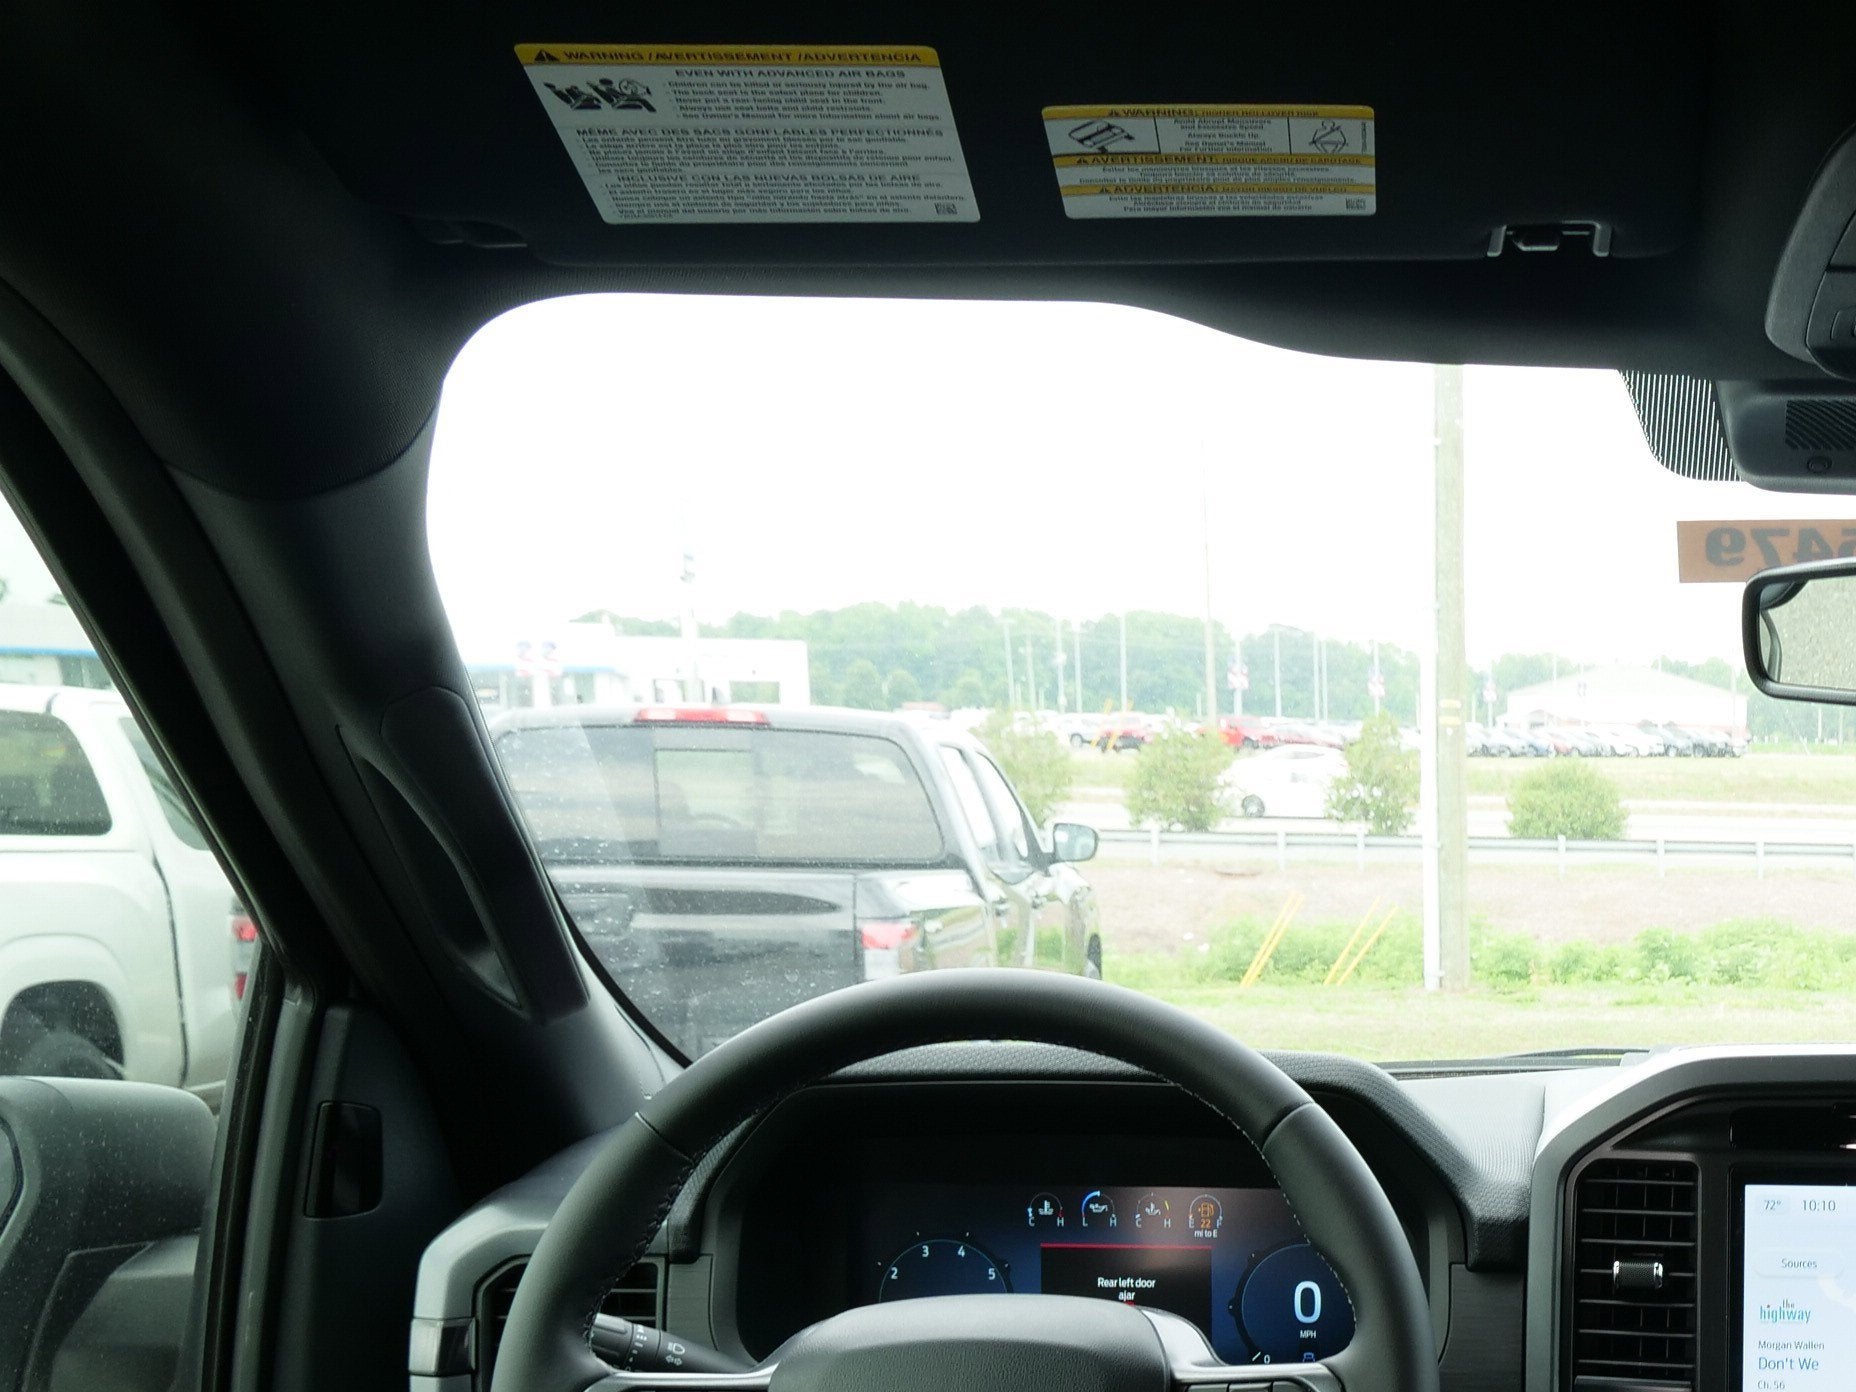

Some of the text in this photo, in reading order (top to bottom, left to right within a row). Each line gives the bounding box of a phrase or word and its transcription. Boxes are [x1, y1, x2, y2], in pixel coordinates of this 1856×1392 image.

[1802, 1199, 1836, 1212] 10:10
[1028, 1217, 1035, 1227] C
[1057, 1217, 1064, 1227] H
[1082, 1217, 1088, 1227] L
[1163, 1218, 1171, 1228] H
[1188, 1219, 1195, 1229] E
[1200, 1219, 1212, 1228] 22
[1216, 1219, 1223, 1229] F
[1194, 1229, 1218, 1238] mi to E
[922, 1245, 929, 1258] 3
[957, 1245, 965, 1258] 4
[1781, 1259, 1818, 1269] Sources
[890, 1267, 898, 1279] 2
[988, 1268, 996, 1280] 5
[1097, 1277, 1155, 1288] Rear left door
[1118, 1290, 1135, 1302] ajar
[1293, 1280, 1322, 1324] 0
[1782, 1299, 1795, 1309] the
[1759, 1303, 1811, 1323] highway
[1299, 1330, 1317, 1339] MPH
[1757, 1340, 1825, 1352] Morgan Wallen
[1263, 1354, 1271, 1364] 0
[1758, 1357, 1819, 1371] Don't We
[1757, 1380, 1786, 1390] Ch. 56
